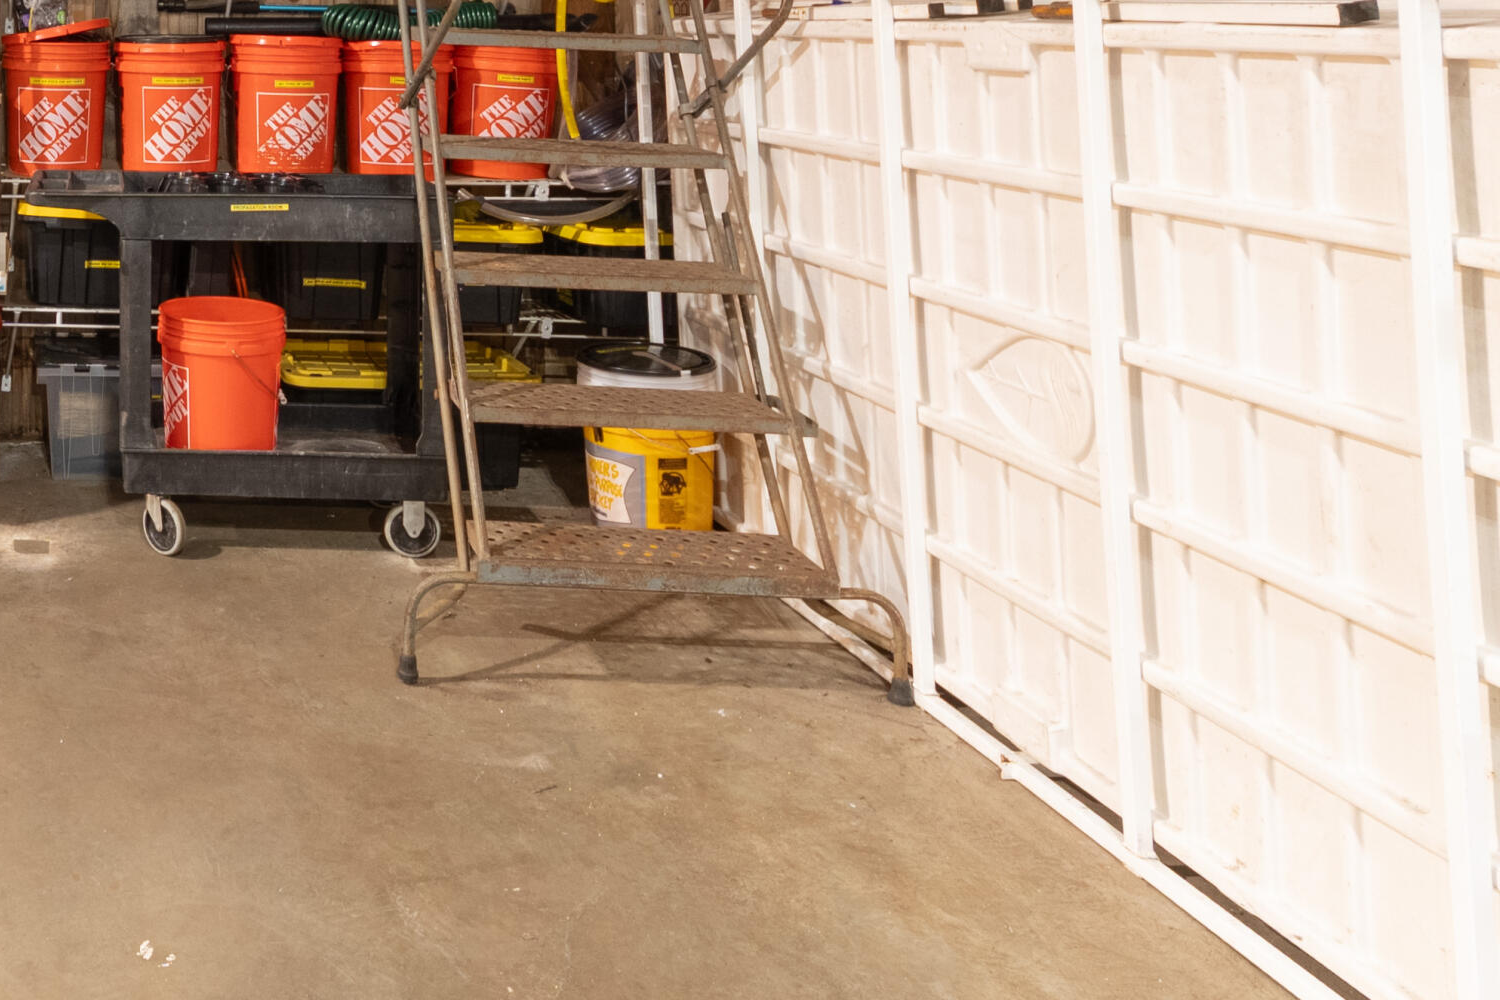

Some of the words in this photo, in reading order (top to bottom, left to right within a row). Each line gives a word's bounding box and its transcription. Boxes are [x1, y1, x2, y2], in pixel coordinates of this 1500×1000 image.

[20, 89, 89, 161] HOME
[24, 96, 54, 127] THE
[144, 88, 212, 162] HOME
[150, 95, 182, 126] THE
[264, 101, 297, 131] THE
[365, 96, 400, 127] THE
[478, 89, 548, 137] OME
[479, 94, 516, 124] THE
[43, 116, 88, 162] DEPOT
[171, 115, 211, 162] DEPOT
